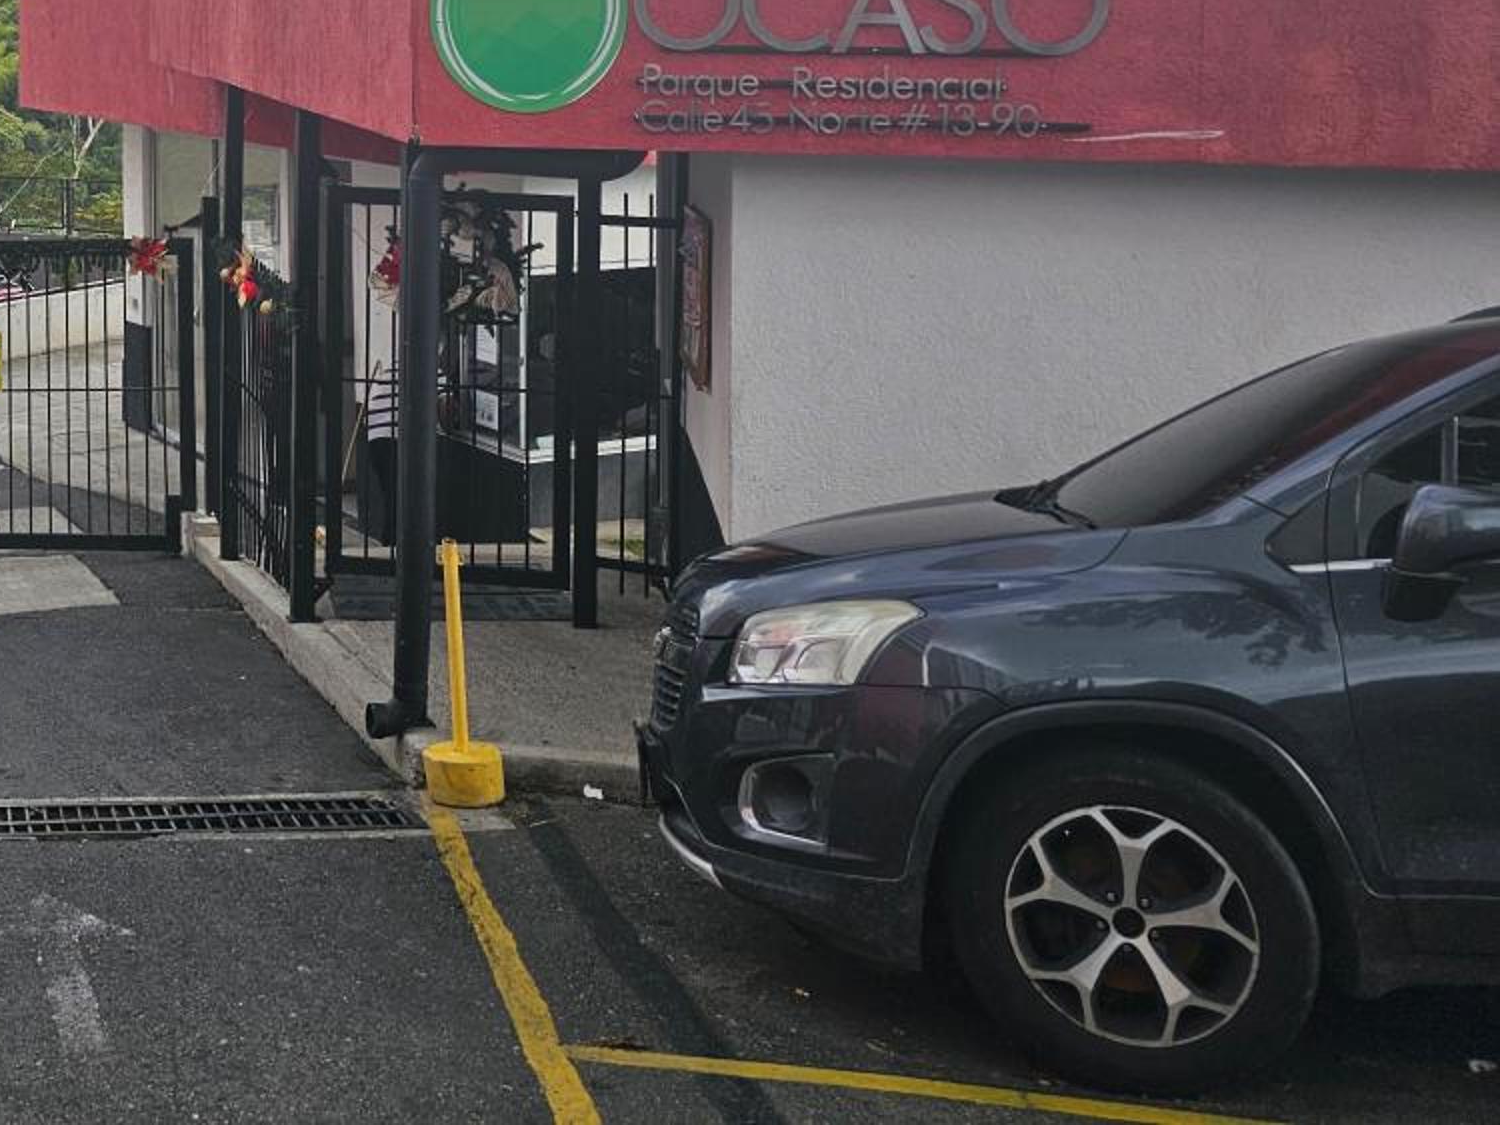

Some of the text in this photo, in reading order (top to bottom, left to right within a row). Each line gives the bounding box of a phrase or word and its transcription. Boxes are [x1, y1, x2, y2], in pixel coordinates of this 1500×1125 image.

[639, 63, 1003, 105] Parque Residencial
[789, 103, 893, 135] Norte
